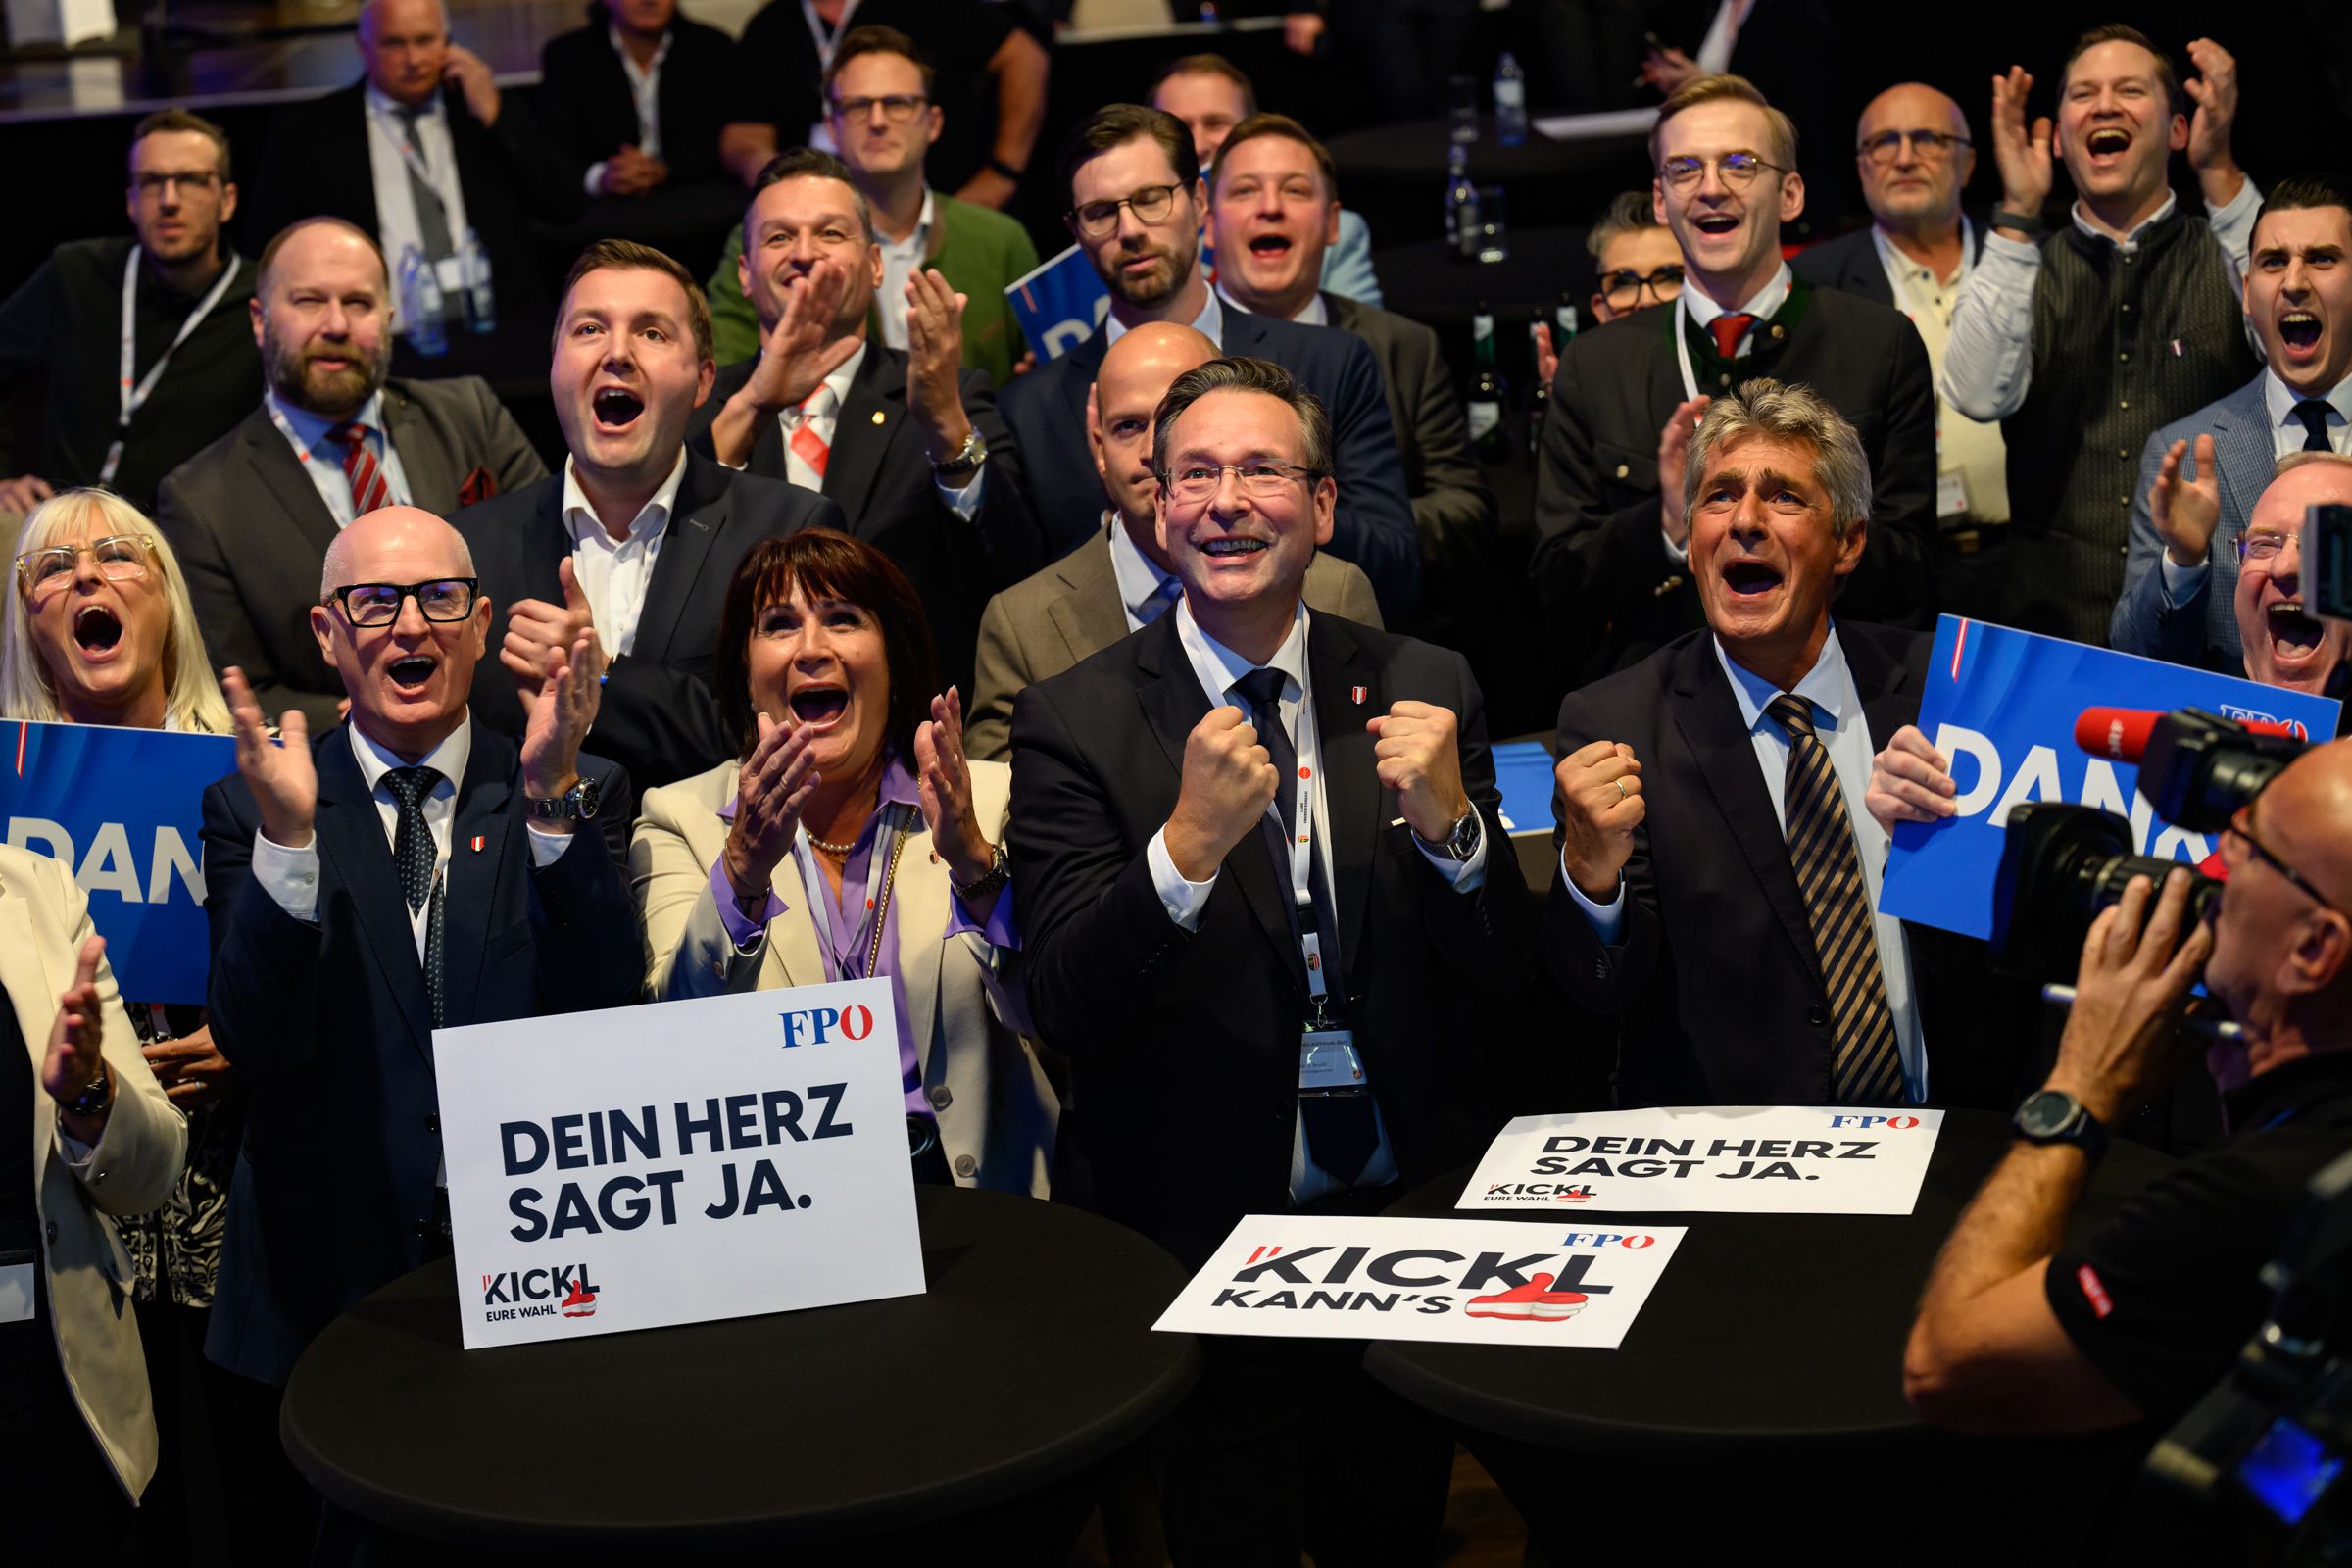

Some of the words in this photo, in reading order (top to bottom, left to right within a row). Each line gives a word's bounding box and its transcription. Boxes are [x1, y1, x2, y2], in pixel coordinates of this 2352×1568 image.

[500, 1104, 662, 1177] DEIN
[673, 1082, 854, 1156] HERZ
[1541, 1136, 1696, 1156] DEIN
[1706, 1139, 1881, 1160] HERZ
[1530, 1156, 1705, 1178] SAGT
[1715, 1161, 1820, 1181] JA.
[508, 1169, 685, 1243] SAGT
[704, 1158, 812, 1220] JA.
[1487, 1183, 1597, 1197] KICKL
[482, 1263, 601, 1305] KICKL
[1231, 1246, 1615, 1295] KICKL
[486, 1308, 517, 1323] EURE
[518, 1304, 558, 1319] WAHL
[1210, 1288, 1457, 1315] KANN'S
